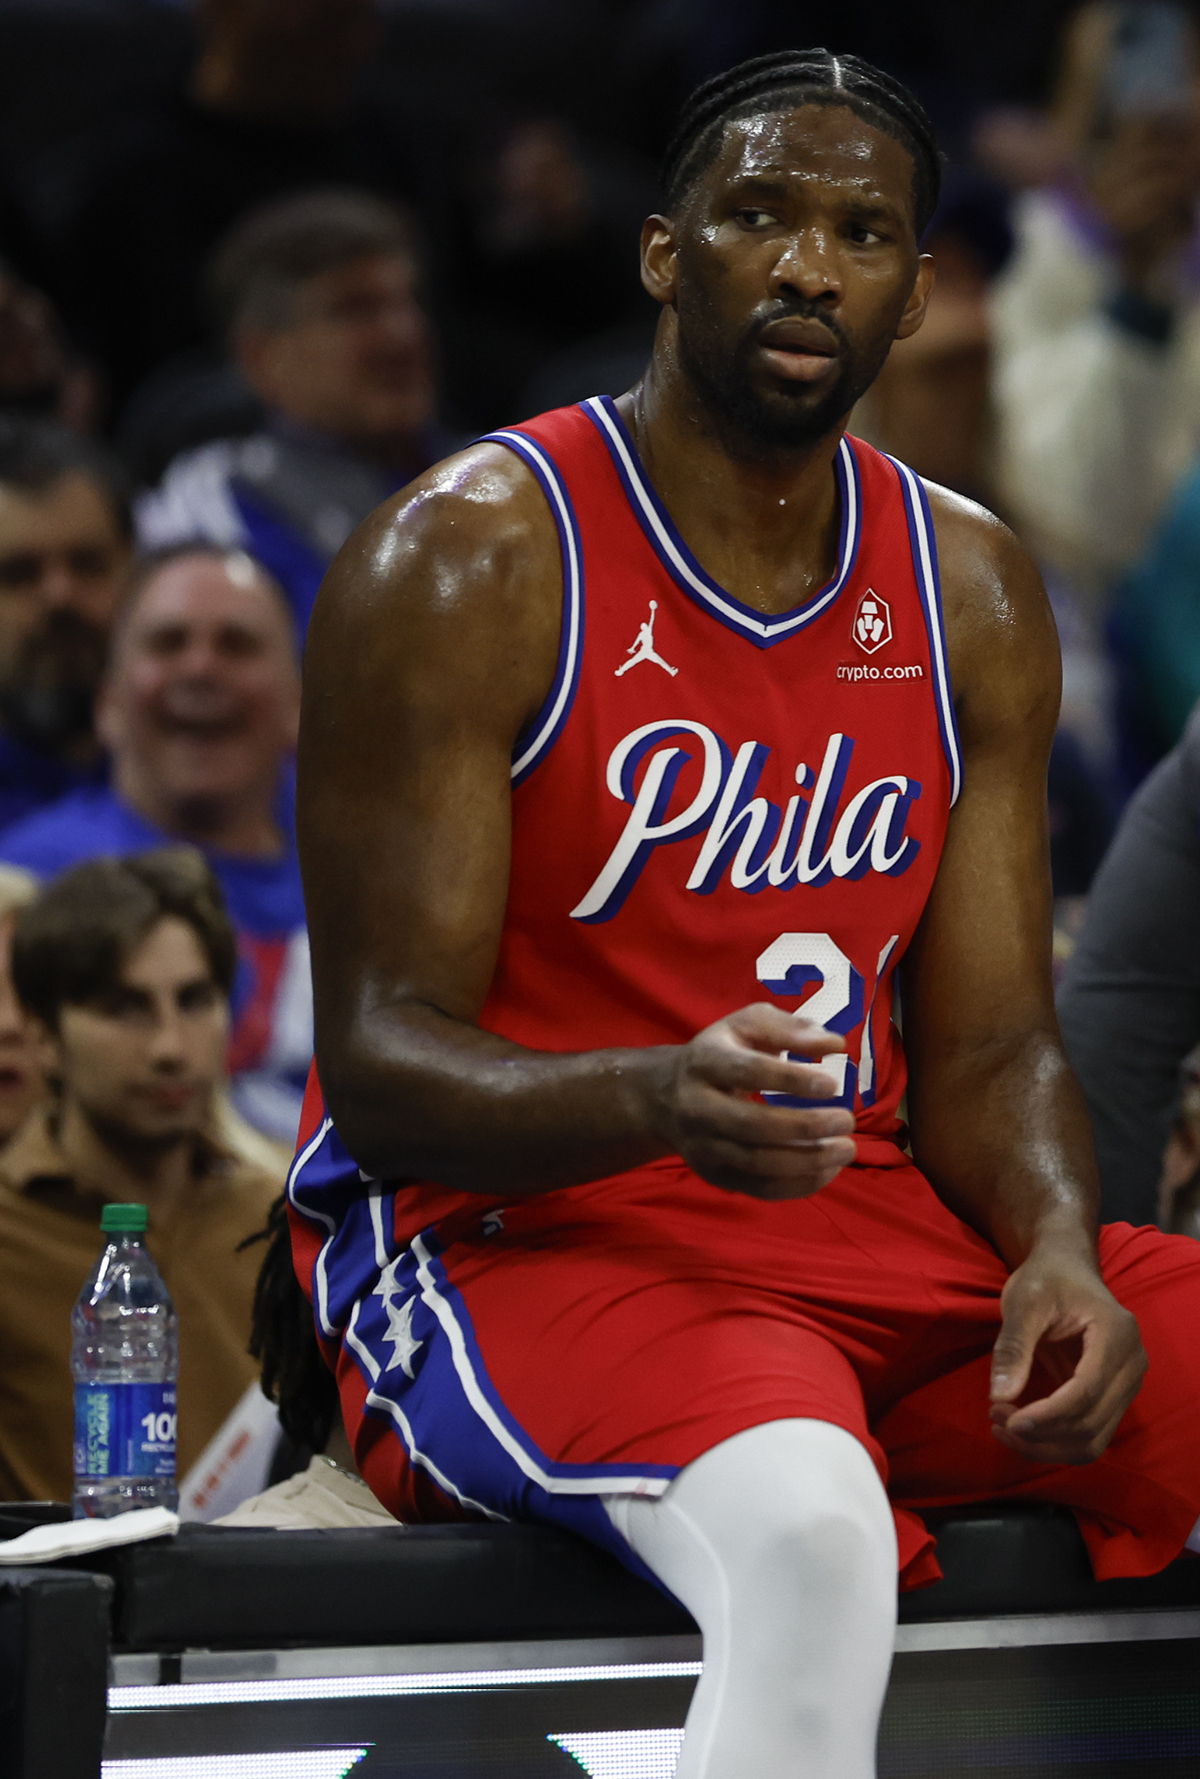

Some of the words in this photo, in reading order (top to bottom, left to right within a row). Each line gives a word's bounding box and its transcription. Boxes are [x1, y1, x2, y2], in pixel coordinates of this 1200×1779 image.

[836, 665, 924, 682] crypto.com
[569, 719, 922, 924] Phila
[87, 1393, 99, 1475] RECYCLE
